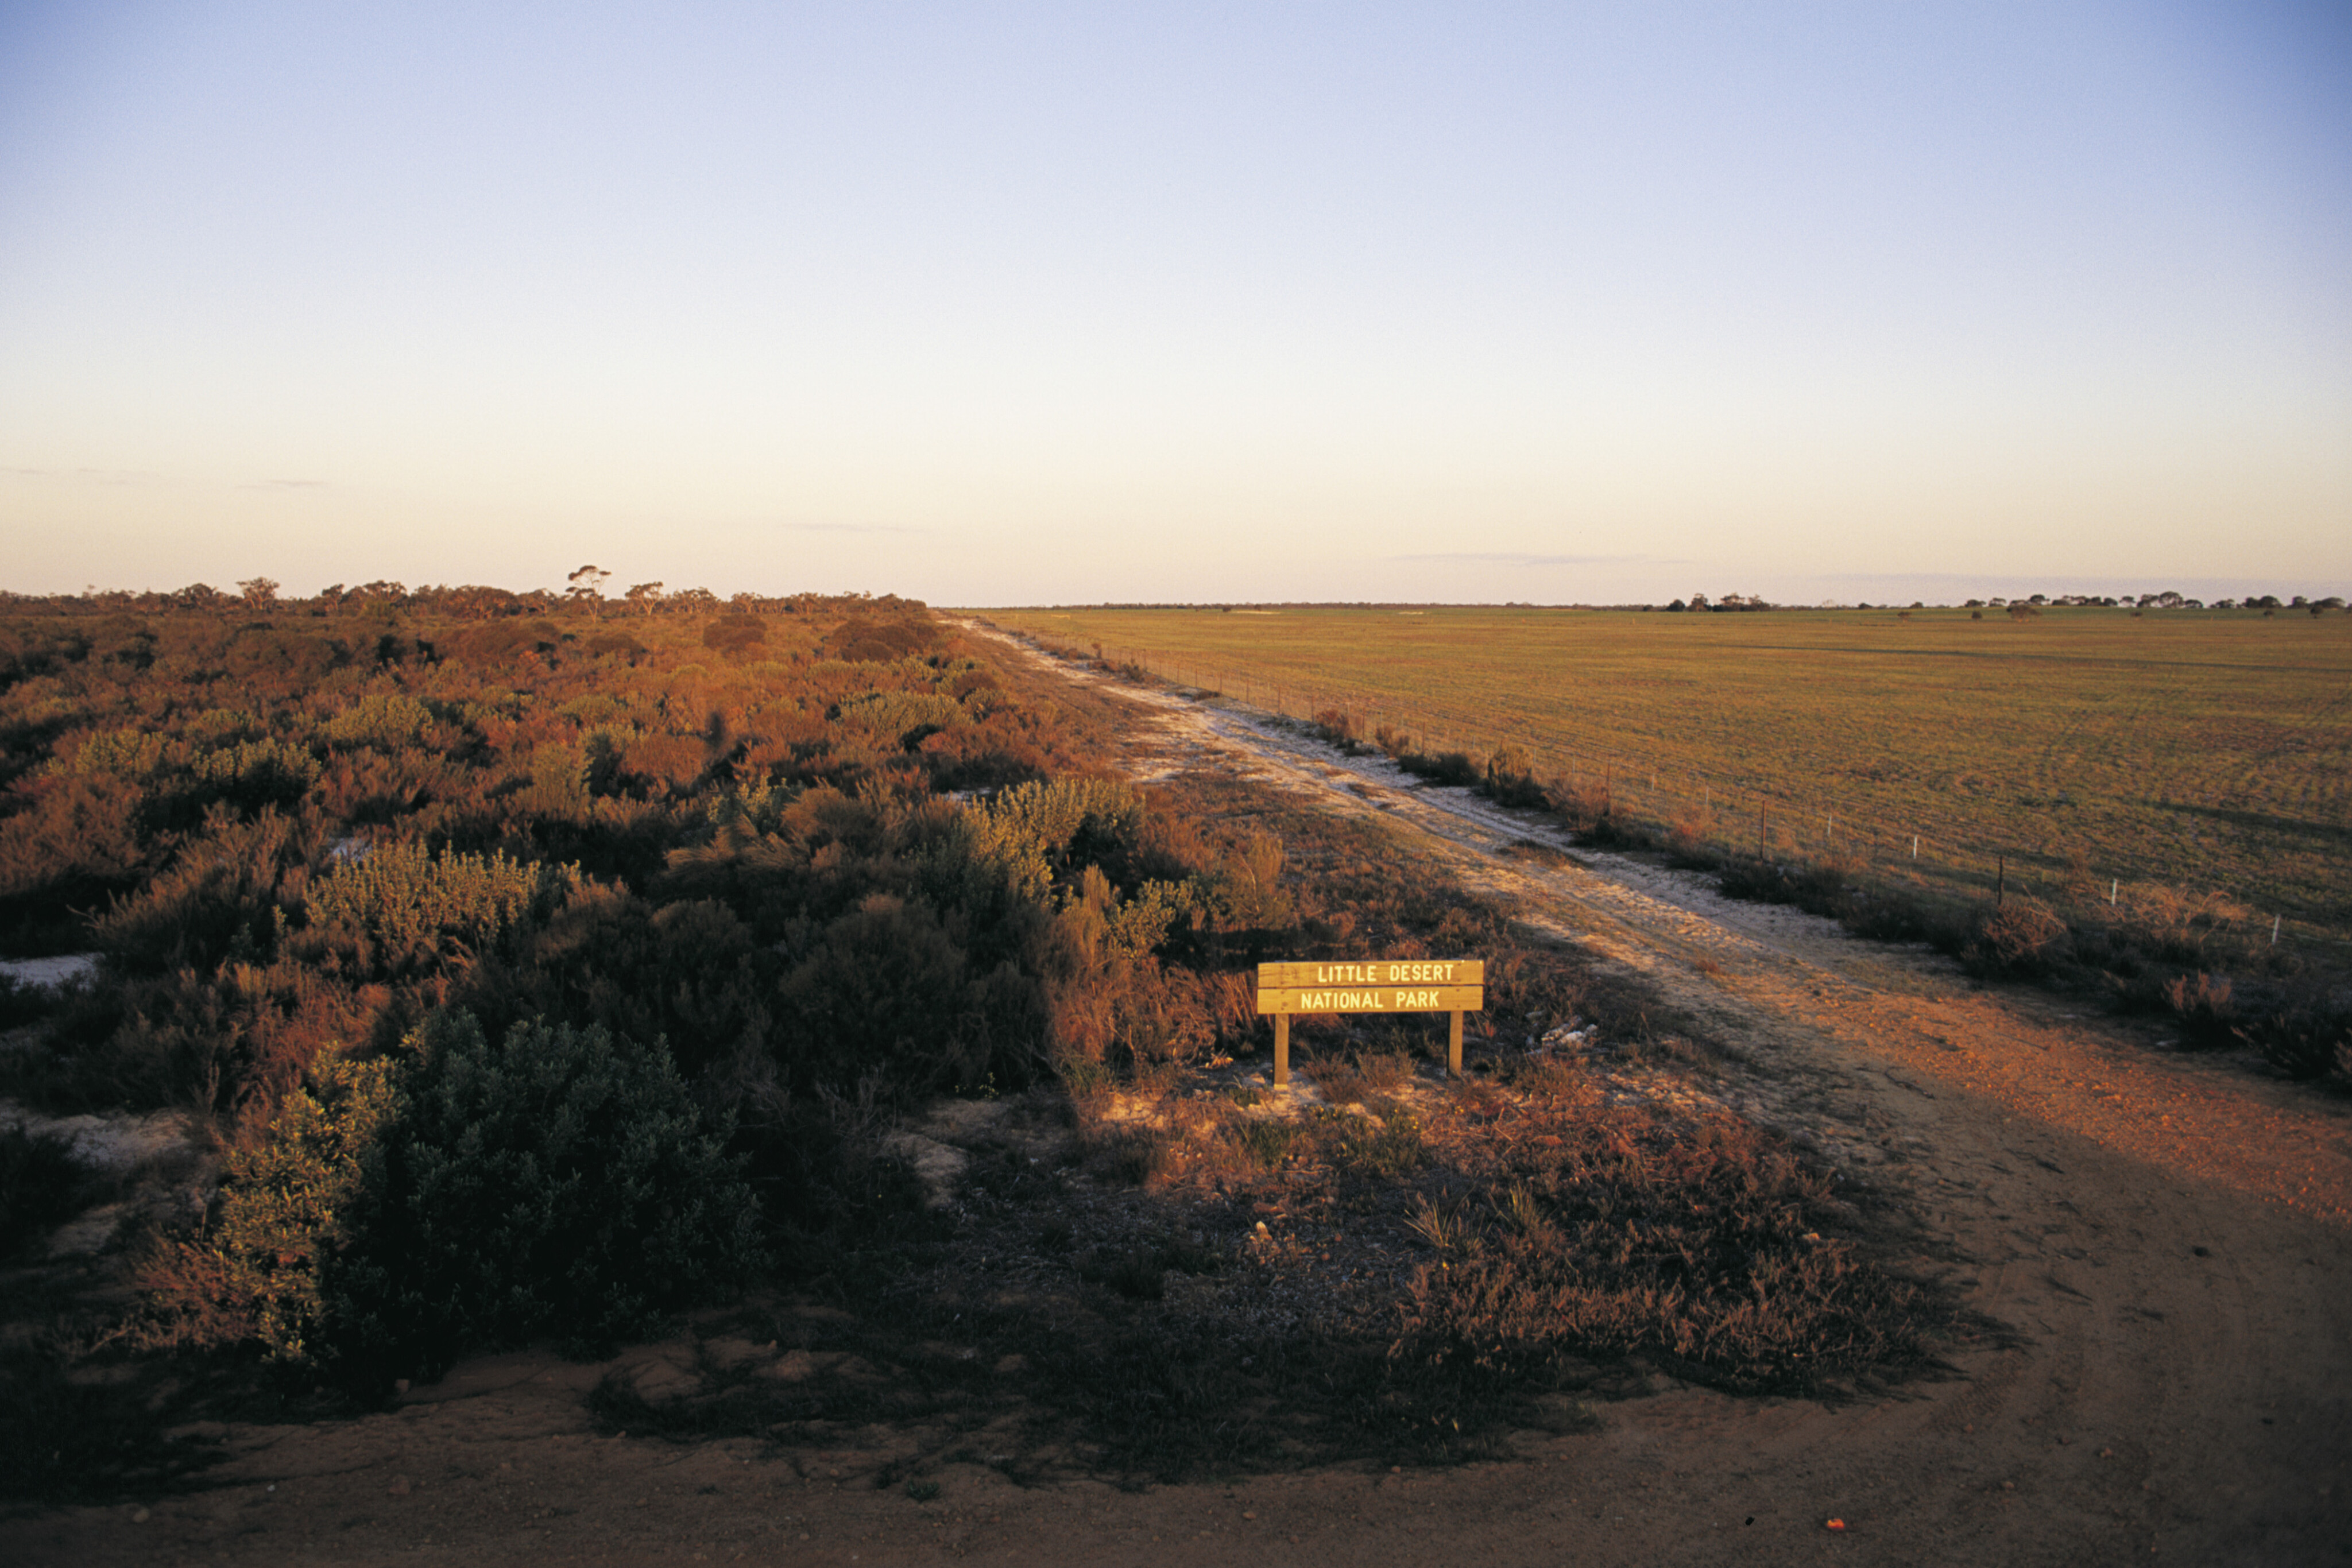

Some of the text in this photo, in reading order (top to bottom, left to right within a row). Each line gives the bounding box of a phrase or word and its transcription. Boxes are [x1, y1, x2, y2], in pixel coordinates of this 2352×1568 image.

[1318, 964, 1454, 982] LITTLE DESERT
[1301, 991, 1439, 1009] NATIONAL PARK
